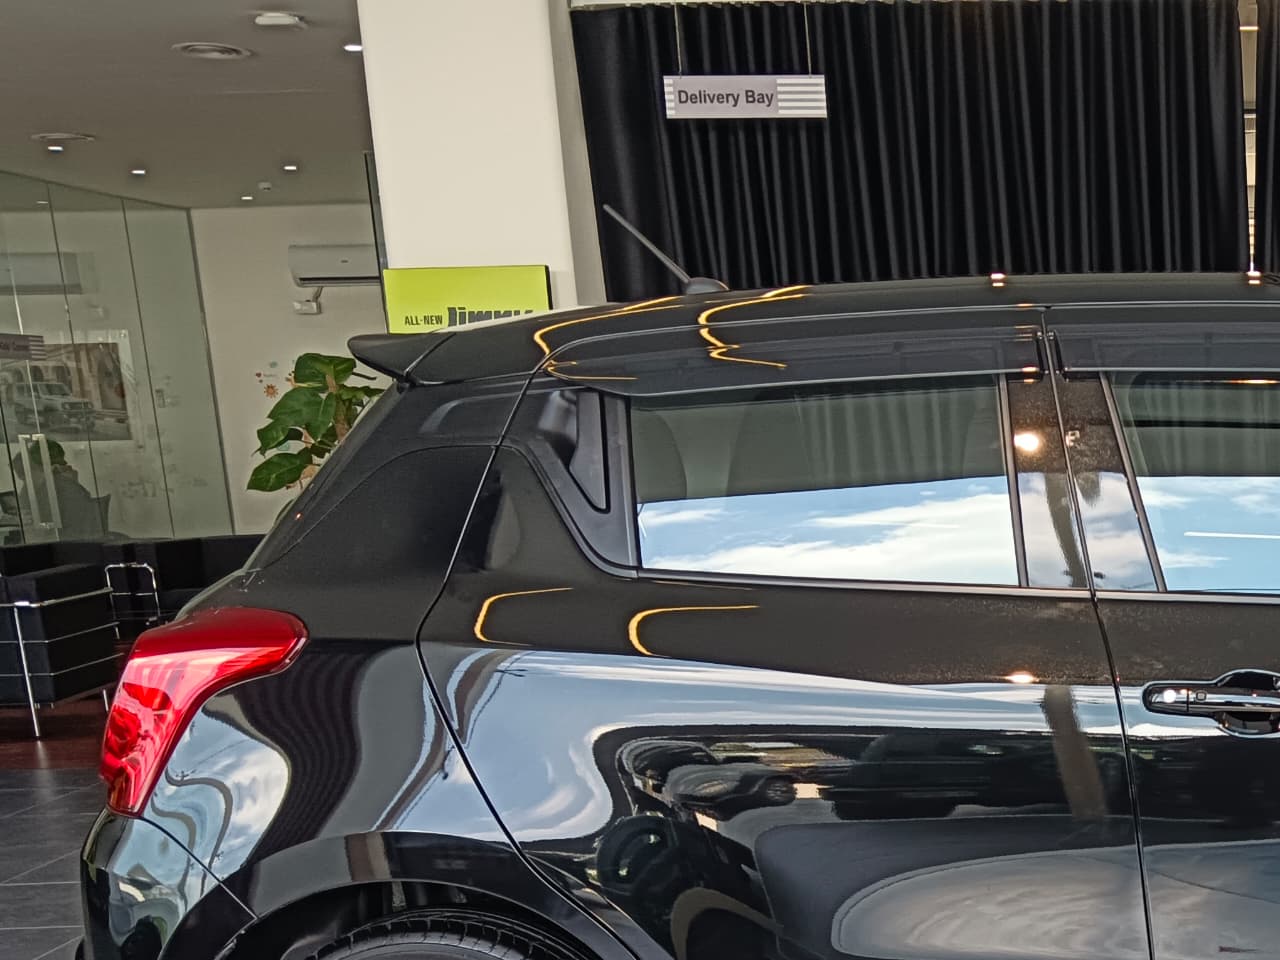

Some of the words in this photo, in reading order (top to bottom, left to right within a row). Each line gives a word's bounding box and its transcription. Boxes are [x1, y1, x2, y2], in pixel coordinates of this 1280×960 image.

[678, 89, 740, 107] Delivery
[745, 89, 774, 107] Bay
[405, 315, 443, 326] ALL-NEW
[447, 306, 534, 327] Jimn
